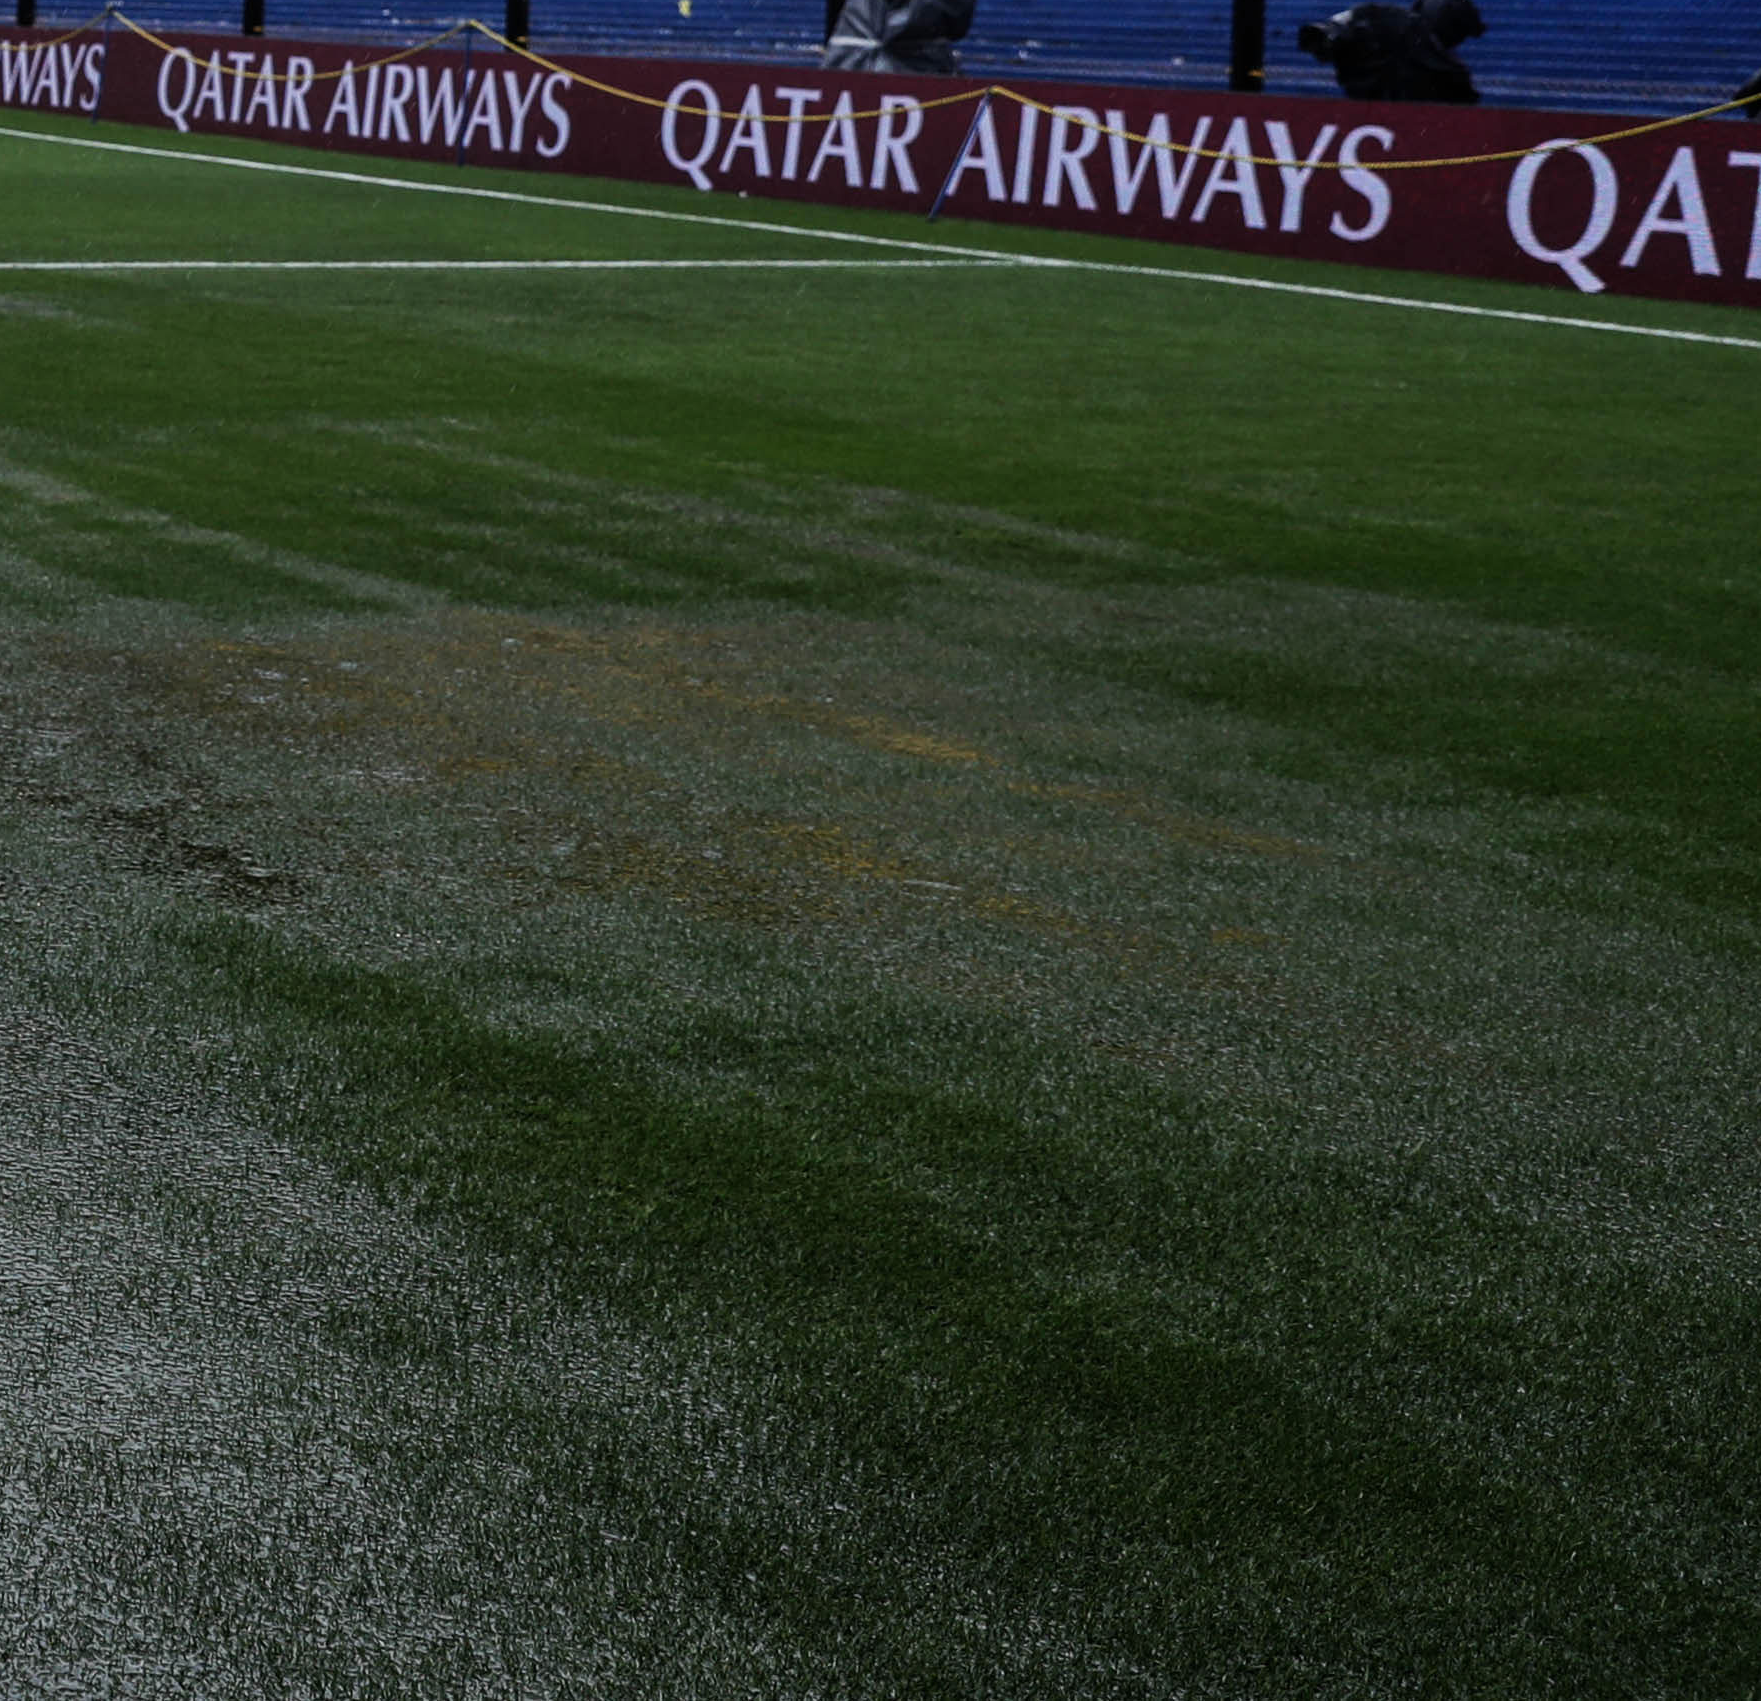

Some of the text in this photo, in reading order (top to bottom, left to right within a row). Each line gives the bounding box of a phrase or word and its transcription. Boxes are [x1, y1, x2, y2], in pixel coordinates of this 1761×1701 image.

[157, 46, 573, 158] QATAR AIRWAYS
[660, 79, 1395, 243] QATAR AIRWAYS
